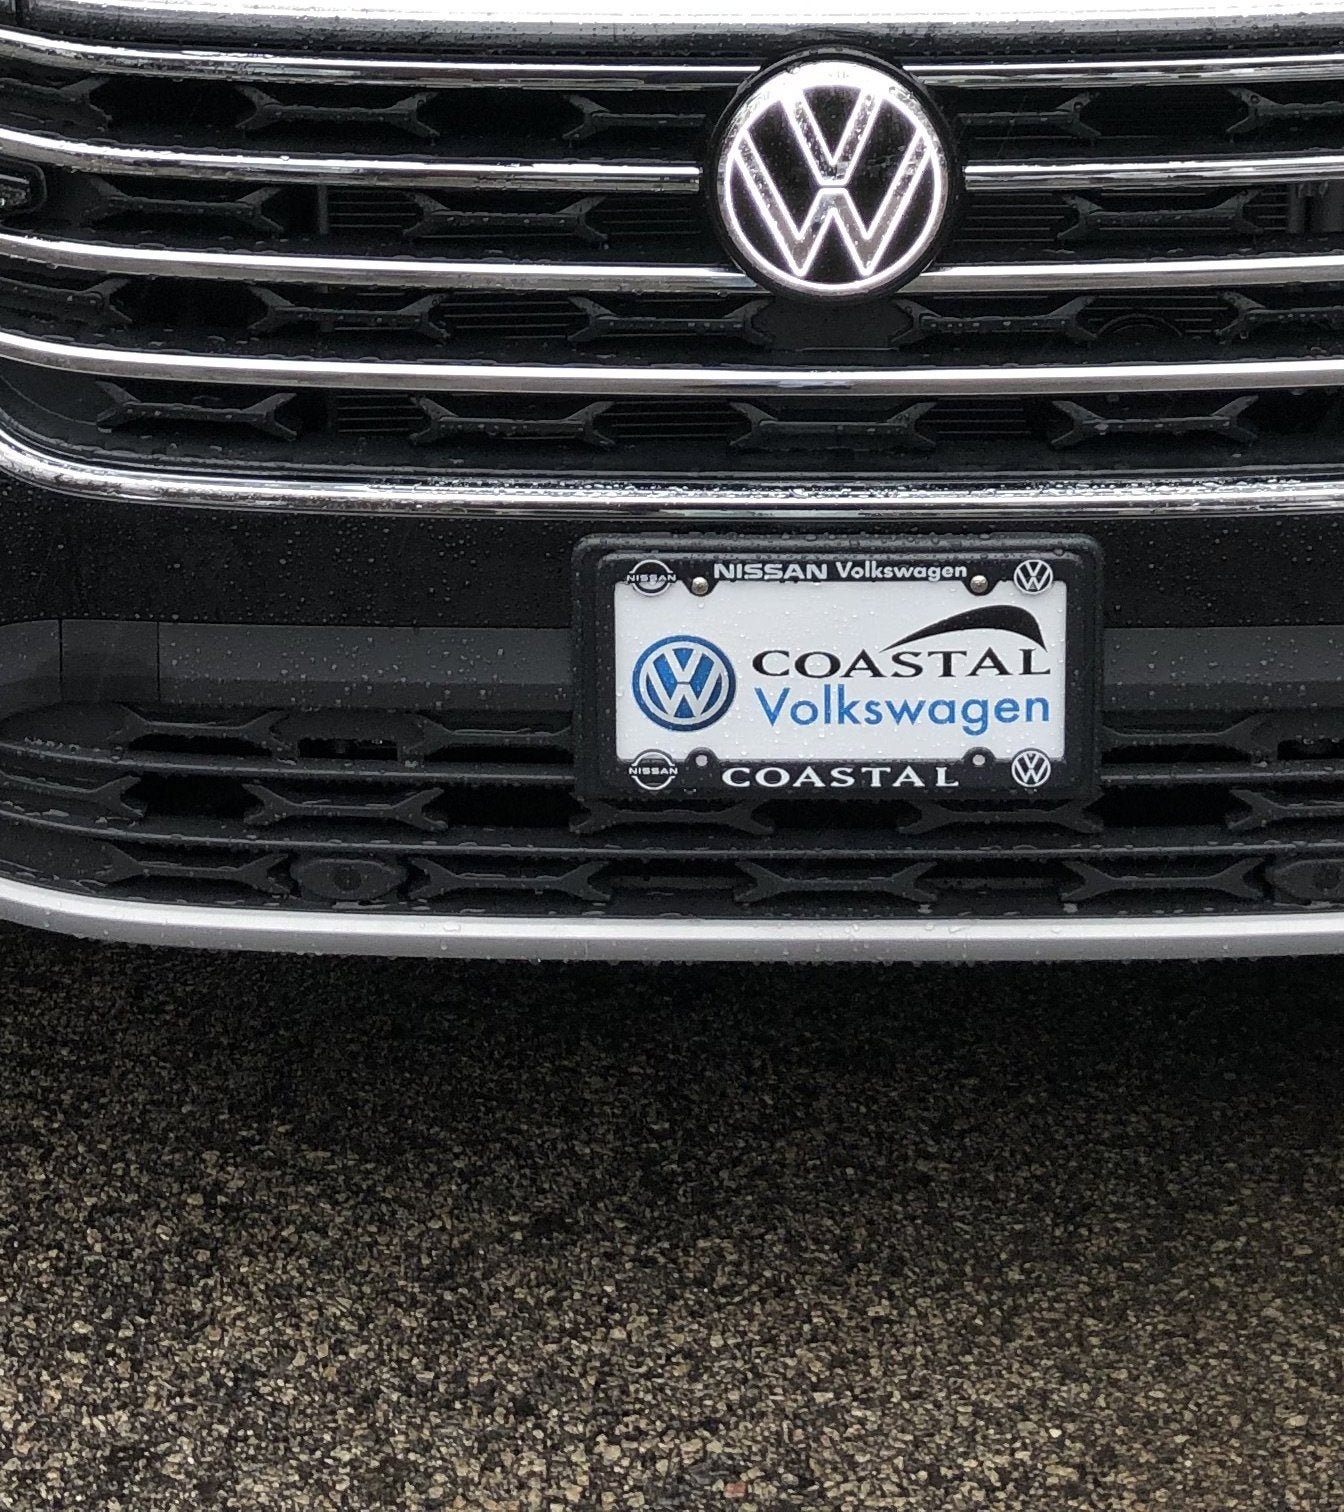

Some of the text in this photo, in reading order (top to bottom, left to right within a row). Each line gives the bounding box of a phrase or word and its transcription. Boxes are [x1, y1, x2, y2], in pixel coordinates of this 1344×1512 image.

[626, 573, 677, 583] NISSAN
[713, 560, 968, 582] NISSAN Volkswagen
[751, 648, 1051, 679] COASTAL
[754, 684, 1050, 737] Volkswagen
[628, 766, 679, 776] NISSAN
[721, 765, 960, 788] COASTAL
